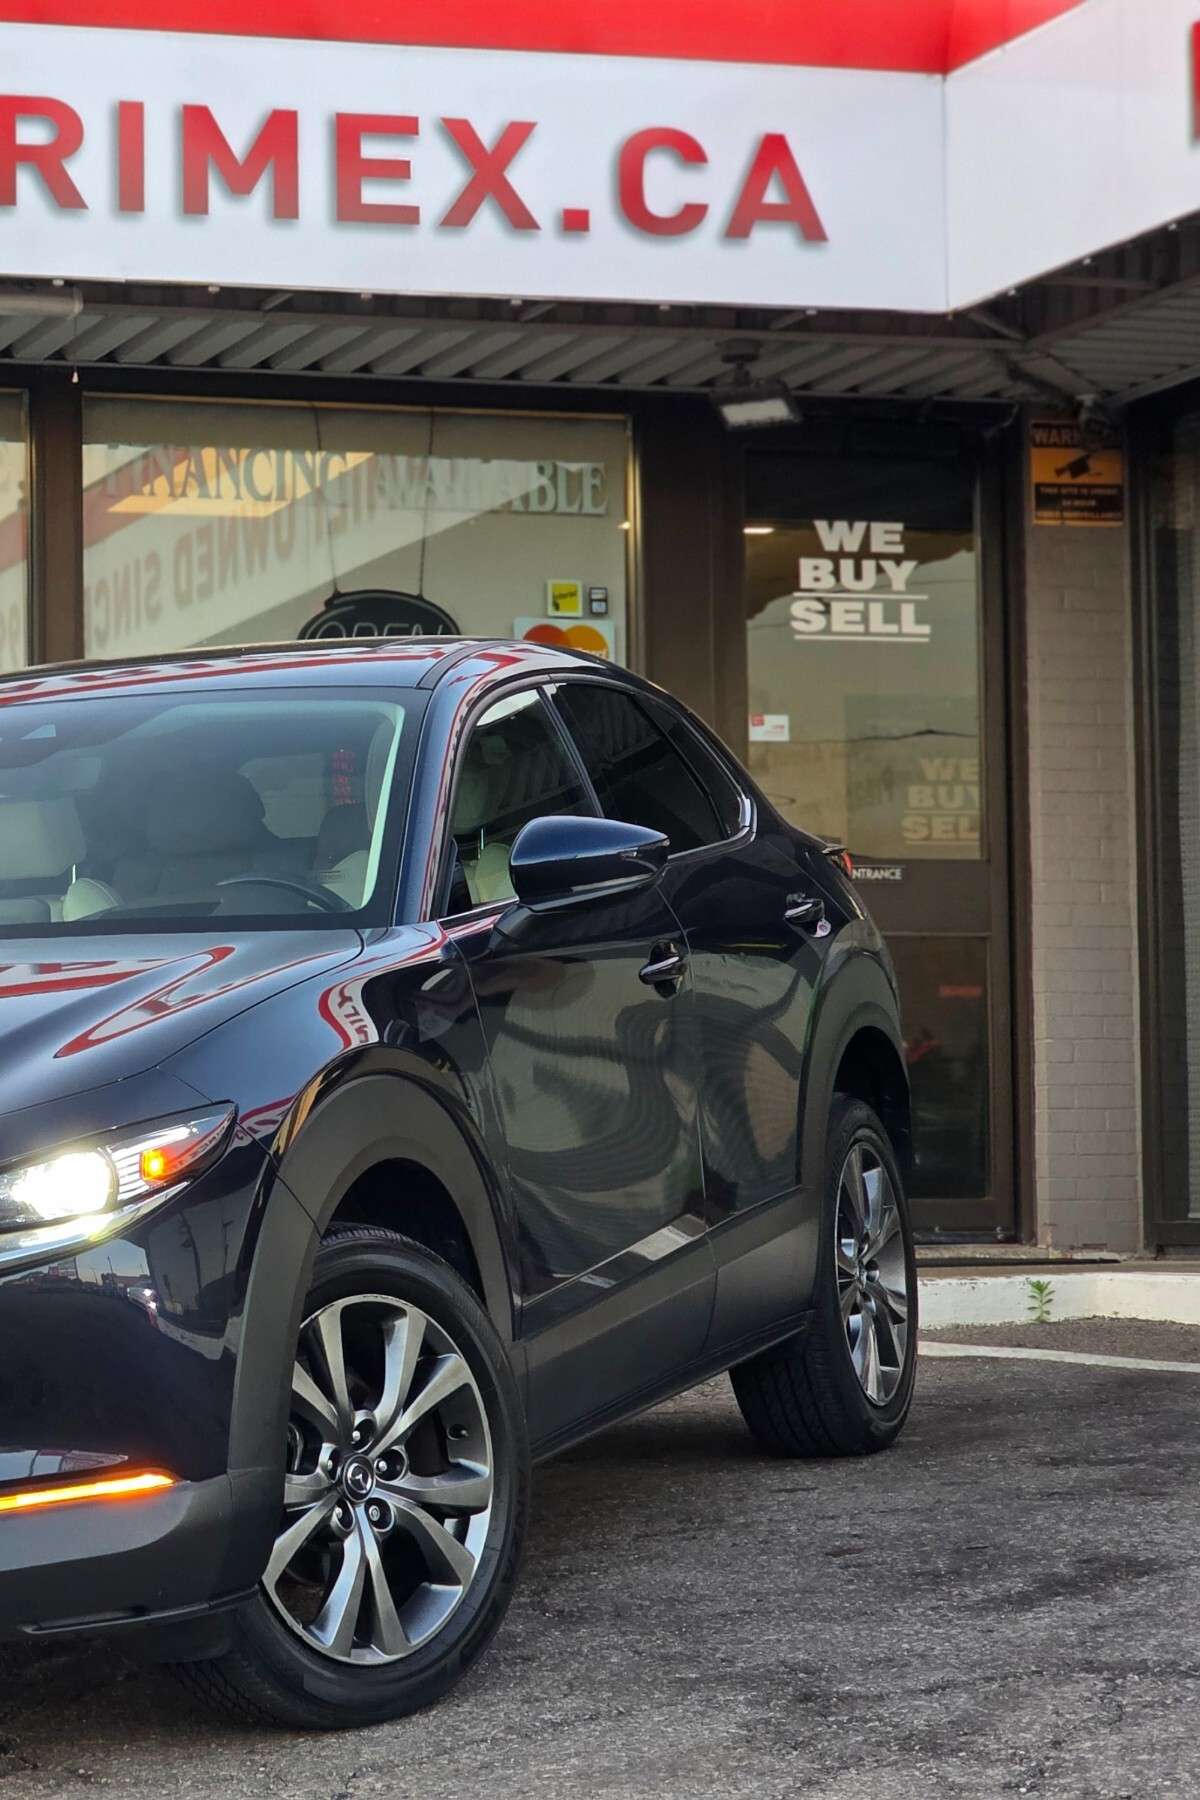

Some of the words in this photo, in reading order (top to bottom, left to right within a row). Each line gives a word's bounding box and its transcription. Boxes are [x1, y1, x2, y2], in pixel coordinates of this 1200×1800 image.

[813, 519, 905, 554] WE
[798, 557, 918, 591] BUY
[790, 600, 931, 636] SELL
[852, 868, 903, 880] NTRANCE
